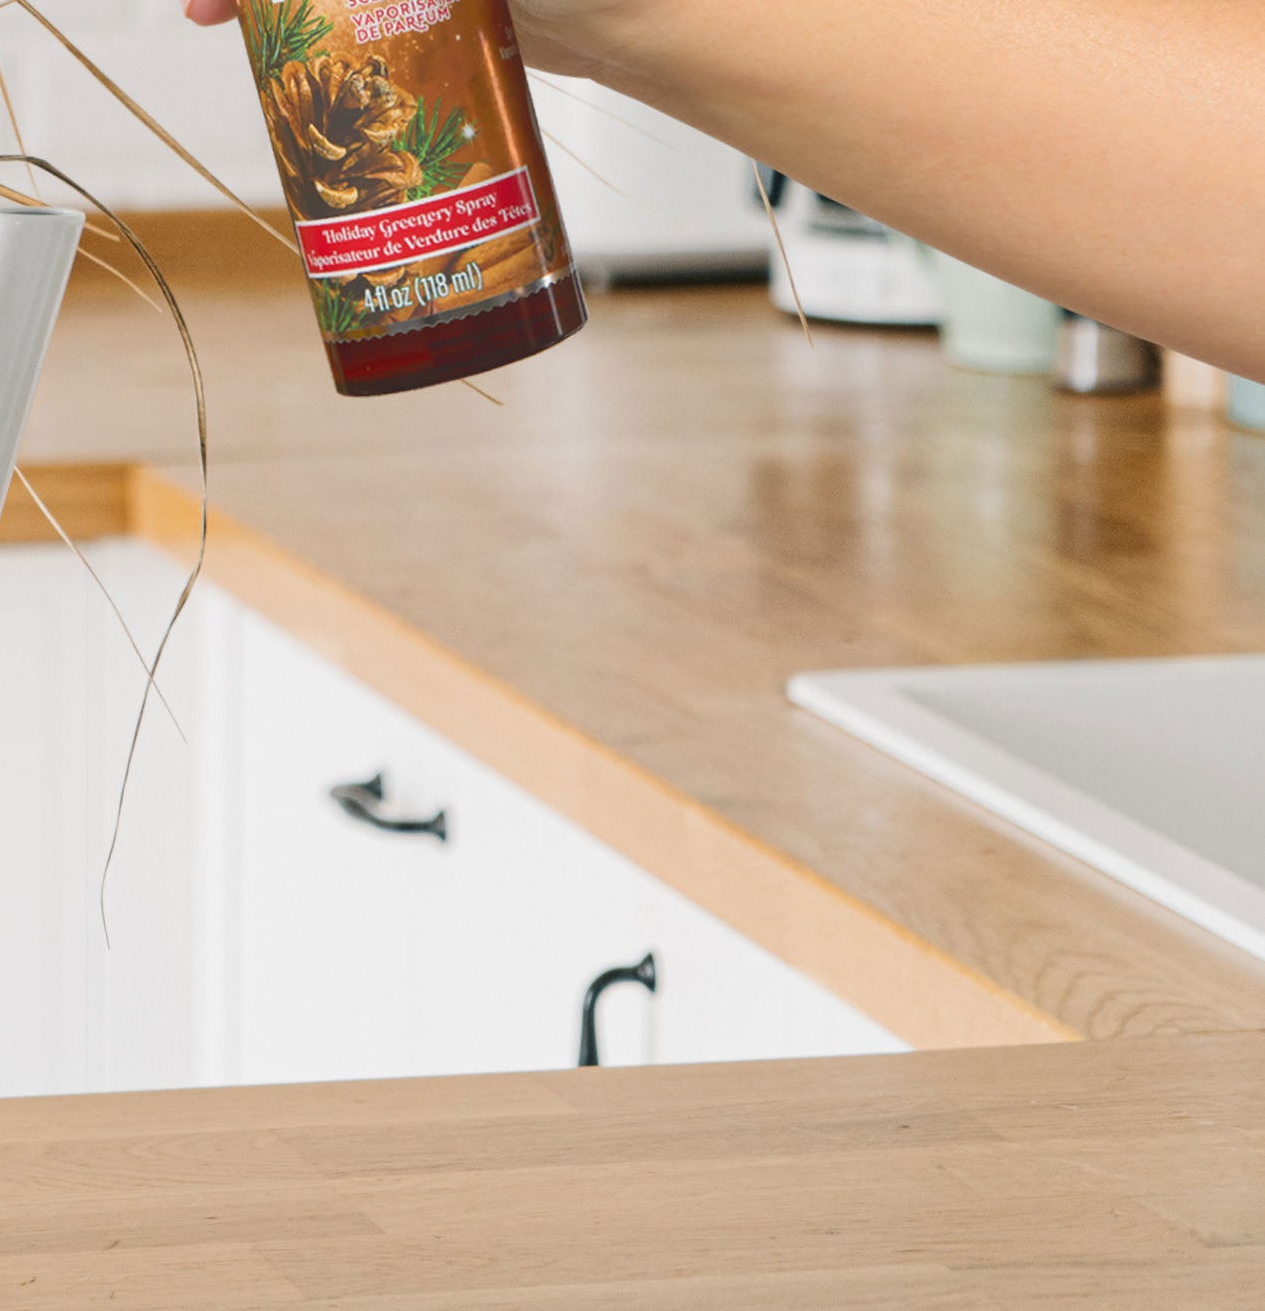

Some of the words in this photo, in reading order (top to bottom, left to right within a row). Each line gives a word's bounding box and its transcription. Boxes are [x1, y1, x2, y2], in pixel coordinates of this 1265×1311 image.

[356, 26, 380, 42] DE
[384, 6, 450, 34] PARFUM
[307, 244, 381, 270] Vaporisateur
[383, 240, 402, 256] de
[404, 224, 470, 249] Verdure
[472, 216, 498, 232] des
[322, 223, 377, 245] Holiday
[379, 205, 453, 237] Greenery
[455, 191, 498, 216] Spray
[392, 287, 413, 308] oz
[415, 274, 450, 306] (118
[452, 262, 483, 292] ml)
